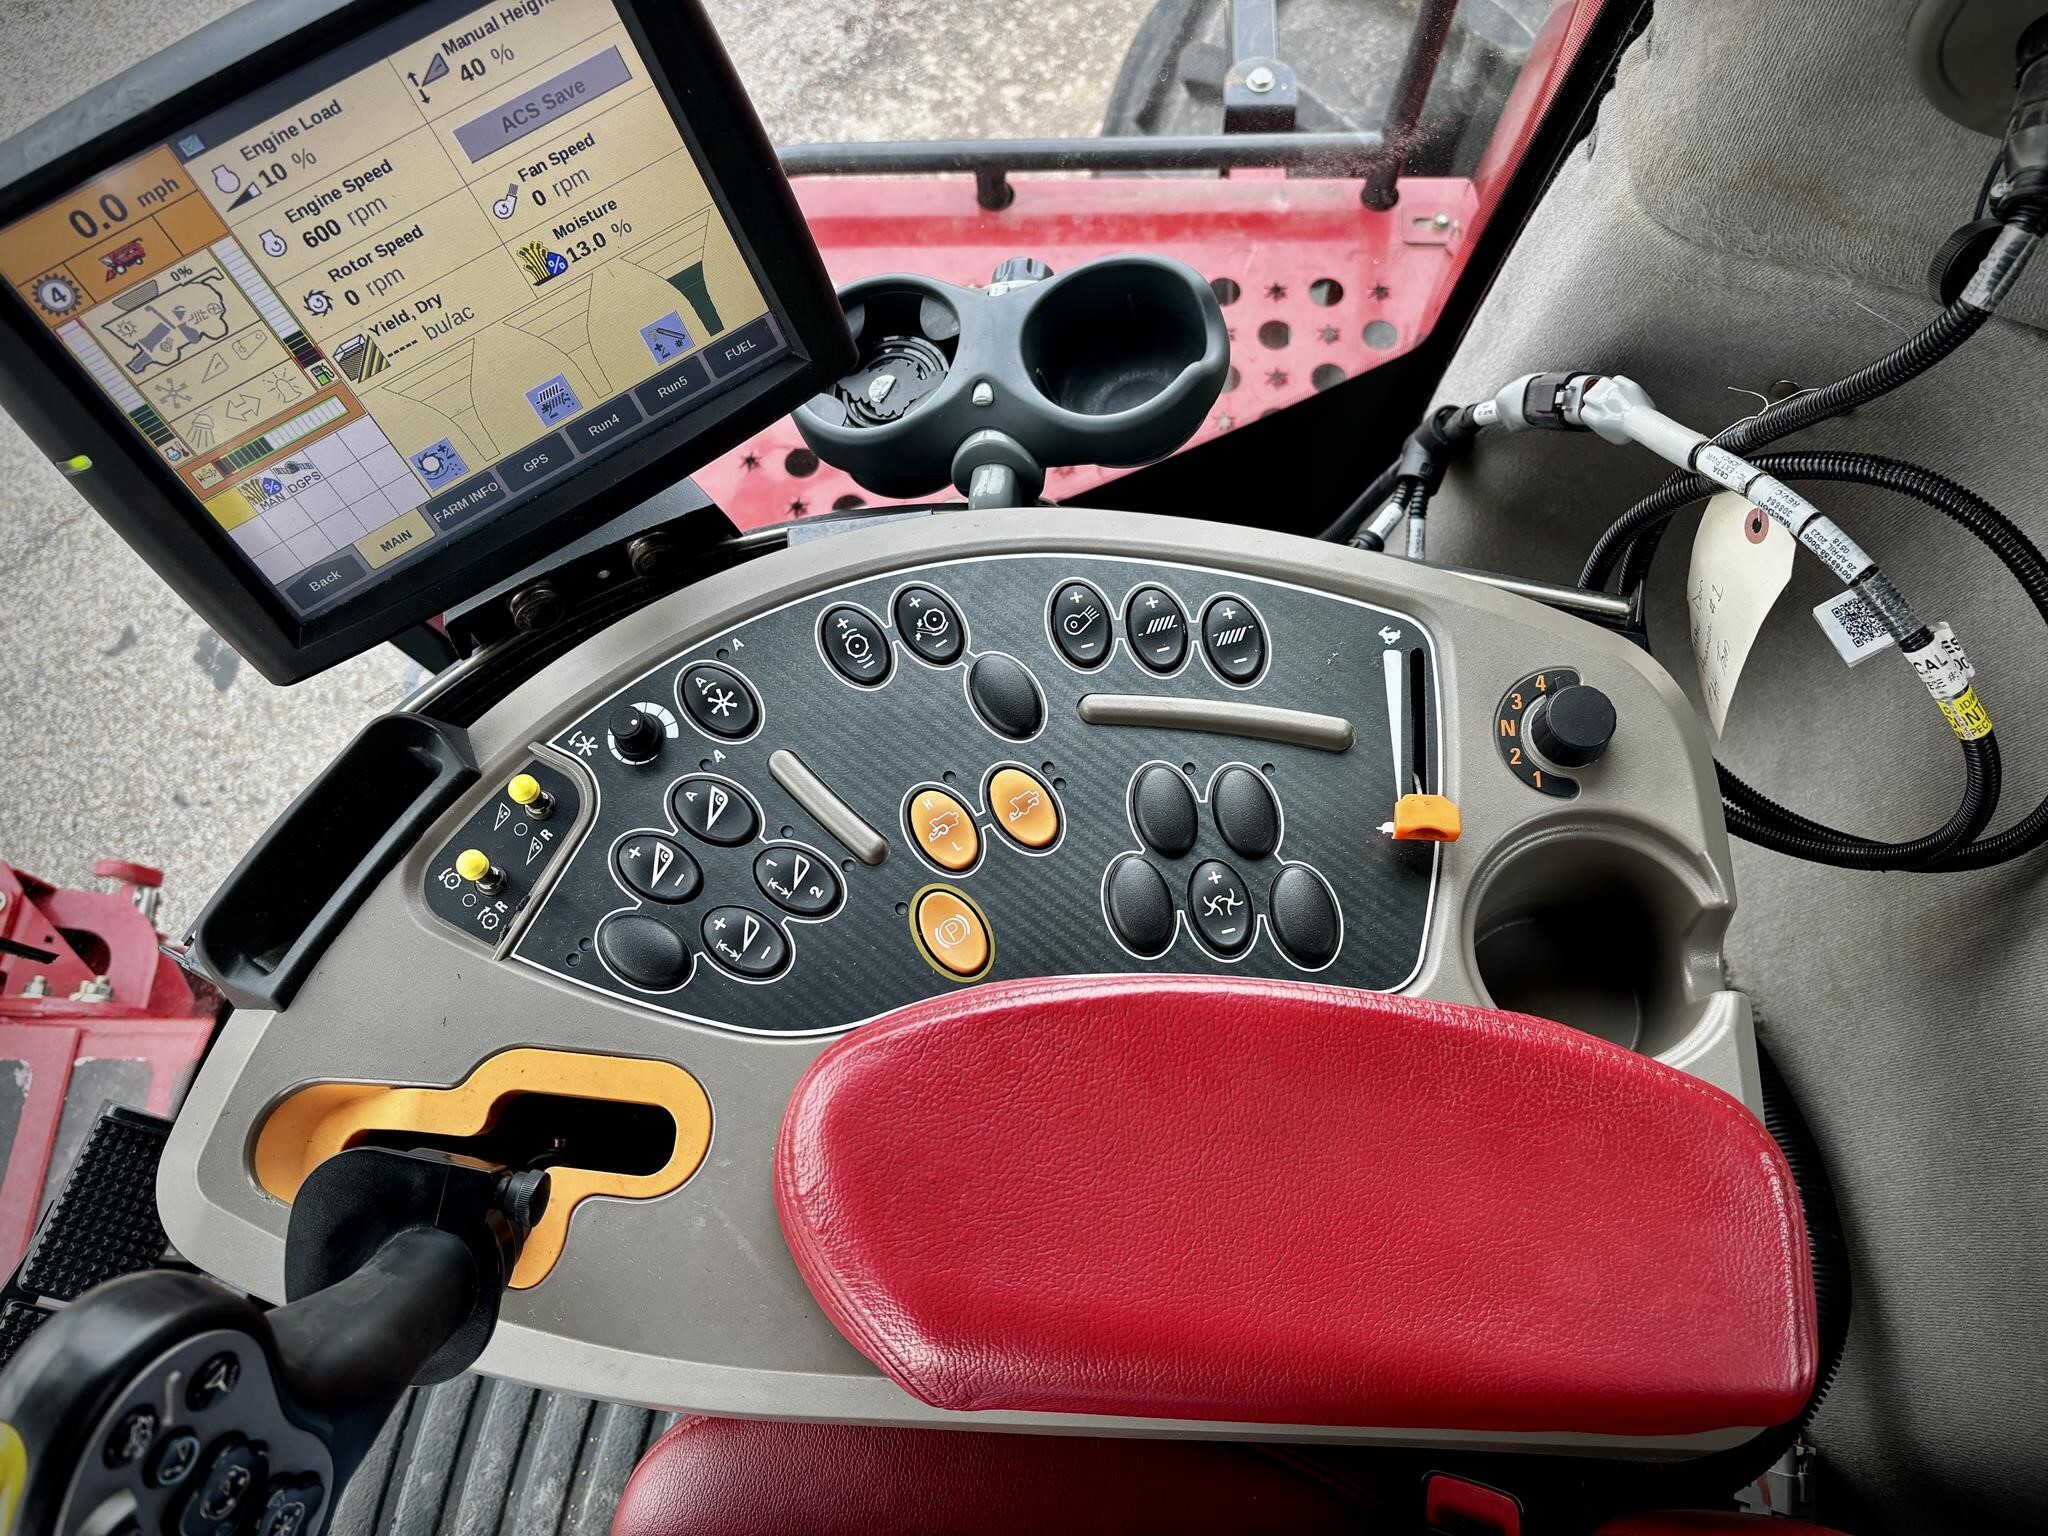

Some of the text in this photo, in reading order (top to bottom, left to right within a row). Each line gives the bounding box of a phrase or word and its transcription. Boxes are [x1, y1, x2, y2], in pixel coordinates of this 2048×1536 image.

[440, 16, 502, 56] Manual
[460, 43, 515, 82] 40 %
[501, 80, 587, 134] ACS Save
[239, 99, 344, 162] Engine Load
[258, 147, 317, 188] 10 %
[517, 132, 597, 183] Fan Speed
[284, 158, 394, 225] Engine Speed
[531, 169, 592, 207] 0 rpm
[69, 177, 181, 239] 0.0 mph
[551, 198, 619, 242] Moisture
[302, 197, 388, 248] 600 rpm
[327, 224, 425, 283] Rotor Speed
[566, 218, 633, 264] 13.0 %
[170, 264, 194, 284] 0%
[51, 286, 67, 303] 4
[344, 268, 406, 306] 0 rpm
[367, 292, 444, 339] Yield, Dry
[421, 305, 477, 342] bu/ac
[724, 339, 758, 362] FUEL
[657, 375, 690, 400] Run5
[587, 413, 621, 438] Run4
[522, 452, 550, 475] GPS
[259, 471, 322, 513] MAN DGPS
[432, 480, 500, 524] FARM INFO
[379, 529, 414, 553] MAIN
[1811, 528, 1828, 545] 2023
[1824, 541, 1847, 564] APRIL
[308, 568, 343, 593] Back
[732, 637, 745, 651] A
[694, 676, 707, 689] A
[1535, 674, 1547, 692] 4
[1511, 693, 1523, 711] 3
[1501, 719, 1516, 738] N
[712, 749, 727, 763] A
[1510, 747, 1522, 766] 2
[1532, 770, 1543, 789] 1
[685, 790, 699, 803] A
[539, 828, 554, 842] R
[809, 885, 824, 899] 2
[494, 900, 509, 914] R
